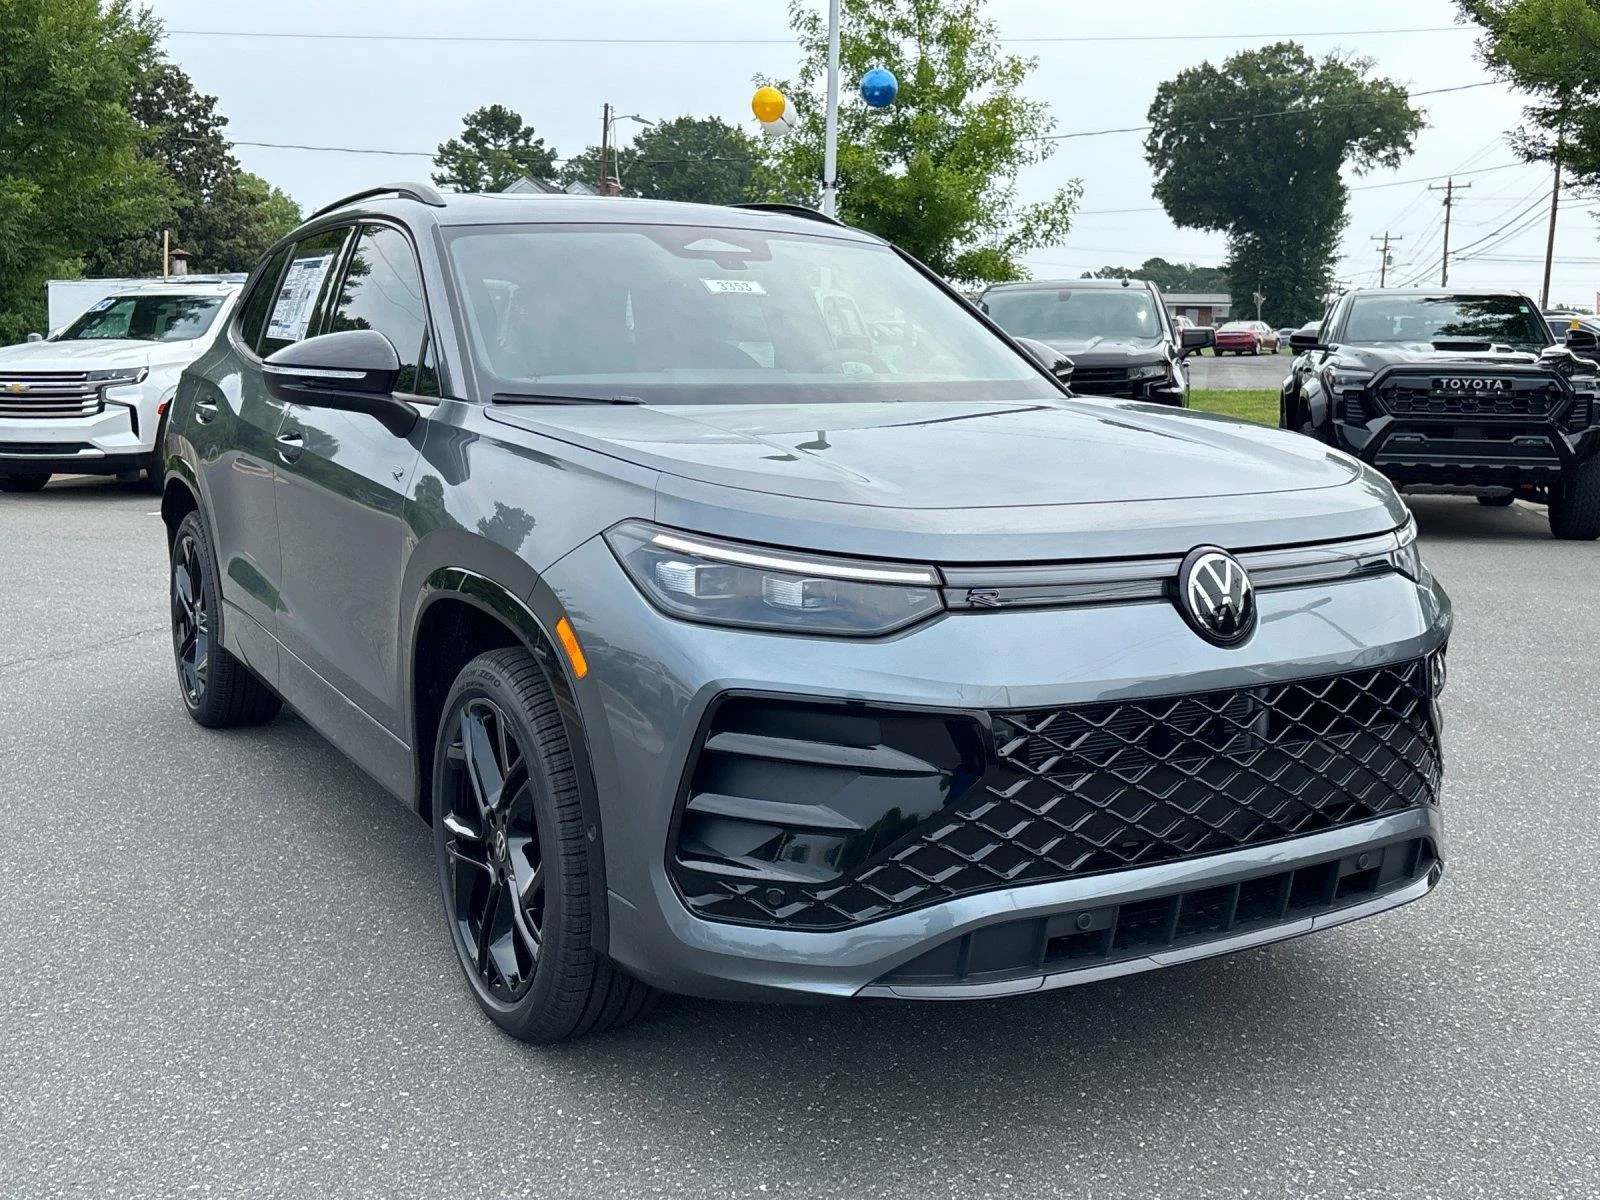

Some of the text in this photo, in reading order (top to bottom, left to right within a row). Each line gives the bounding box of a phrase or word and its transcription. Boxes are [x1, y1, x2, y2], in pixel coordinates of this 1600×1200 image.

[716, 281, 753, 291] 3353
[1440, 379, 1504, 389] TOYOTA
[478, 669, 502, 688] ZERO
